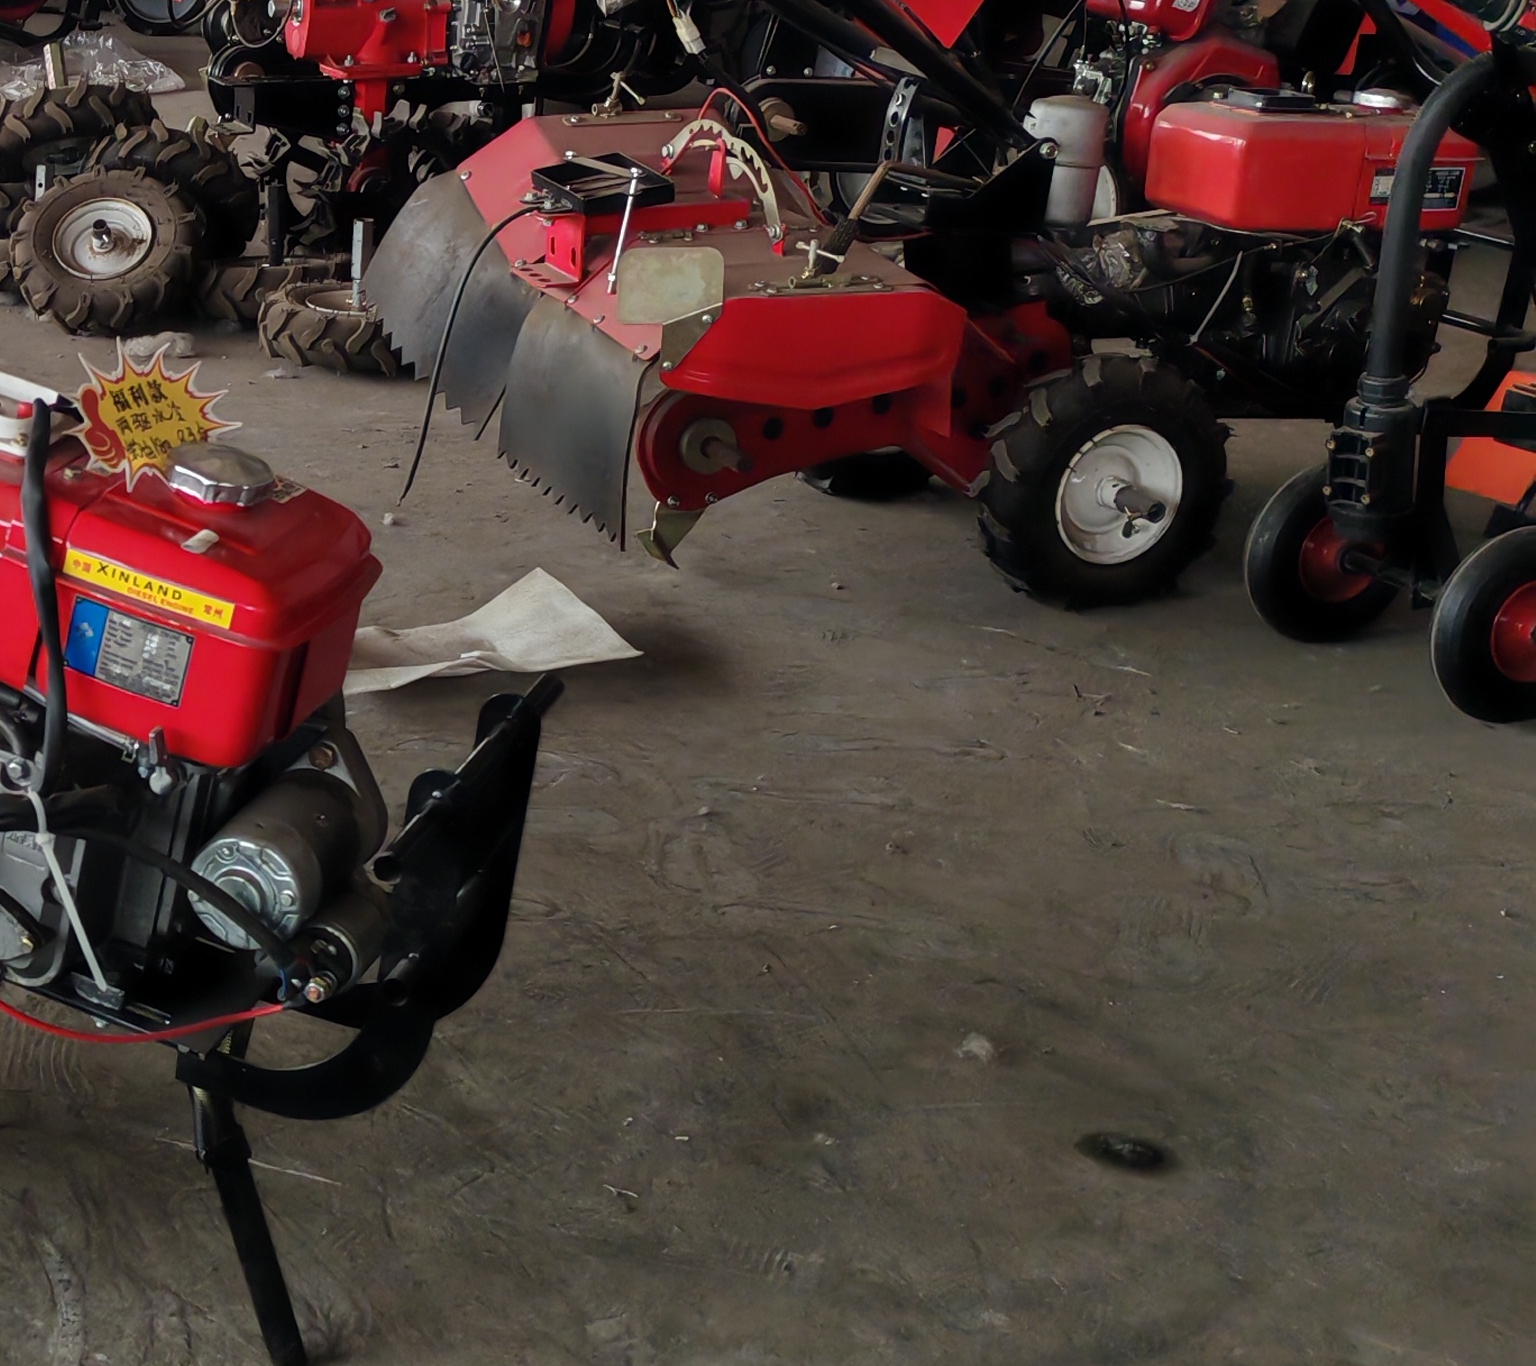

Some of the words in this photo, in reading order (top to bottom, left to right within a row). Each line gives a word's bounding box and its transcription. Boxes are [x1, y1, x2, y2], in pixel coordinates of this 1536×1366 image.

[96, 561, 182, 601] XINLAND
[127, 586, 157, 605] DIESEL
[160, 598, 195, 615] ENGINE
